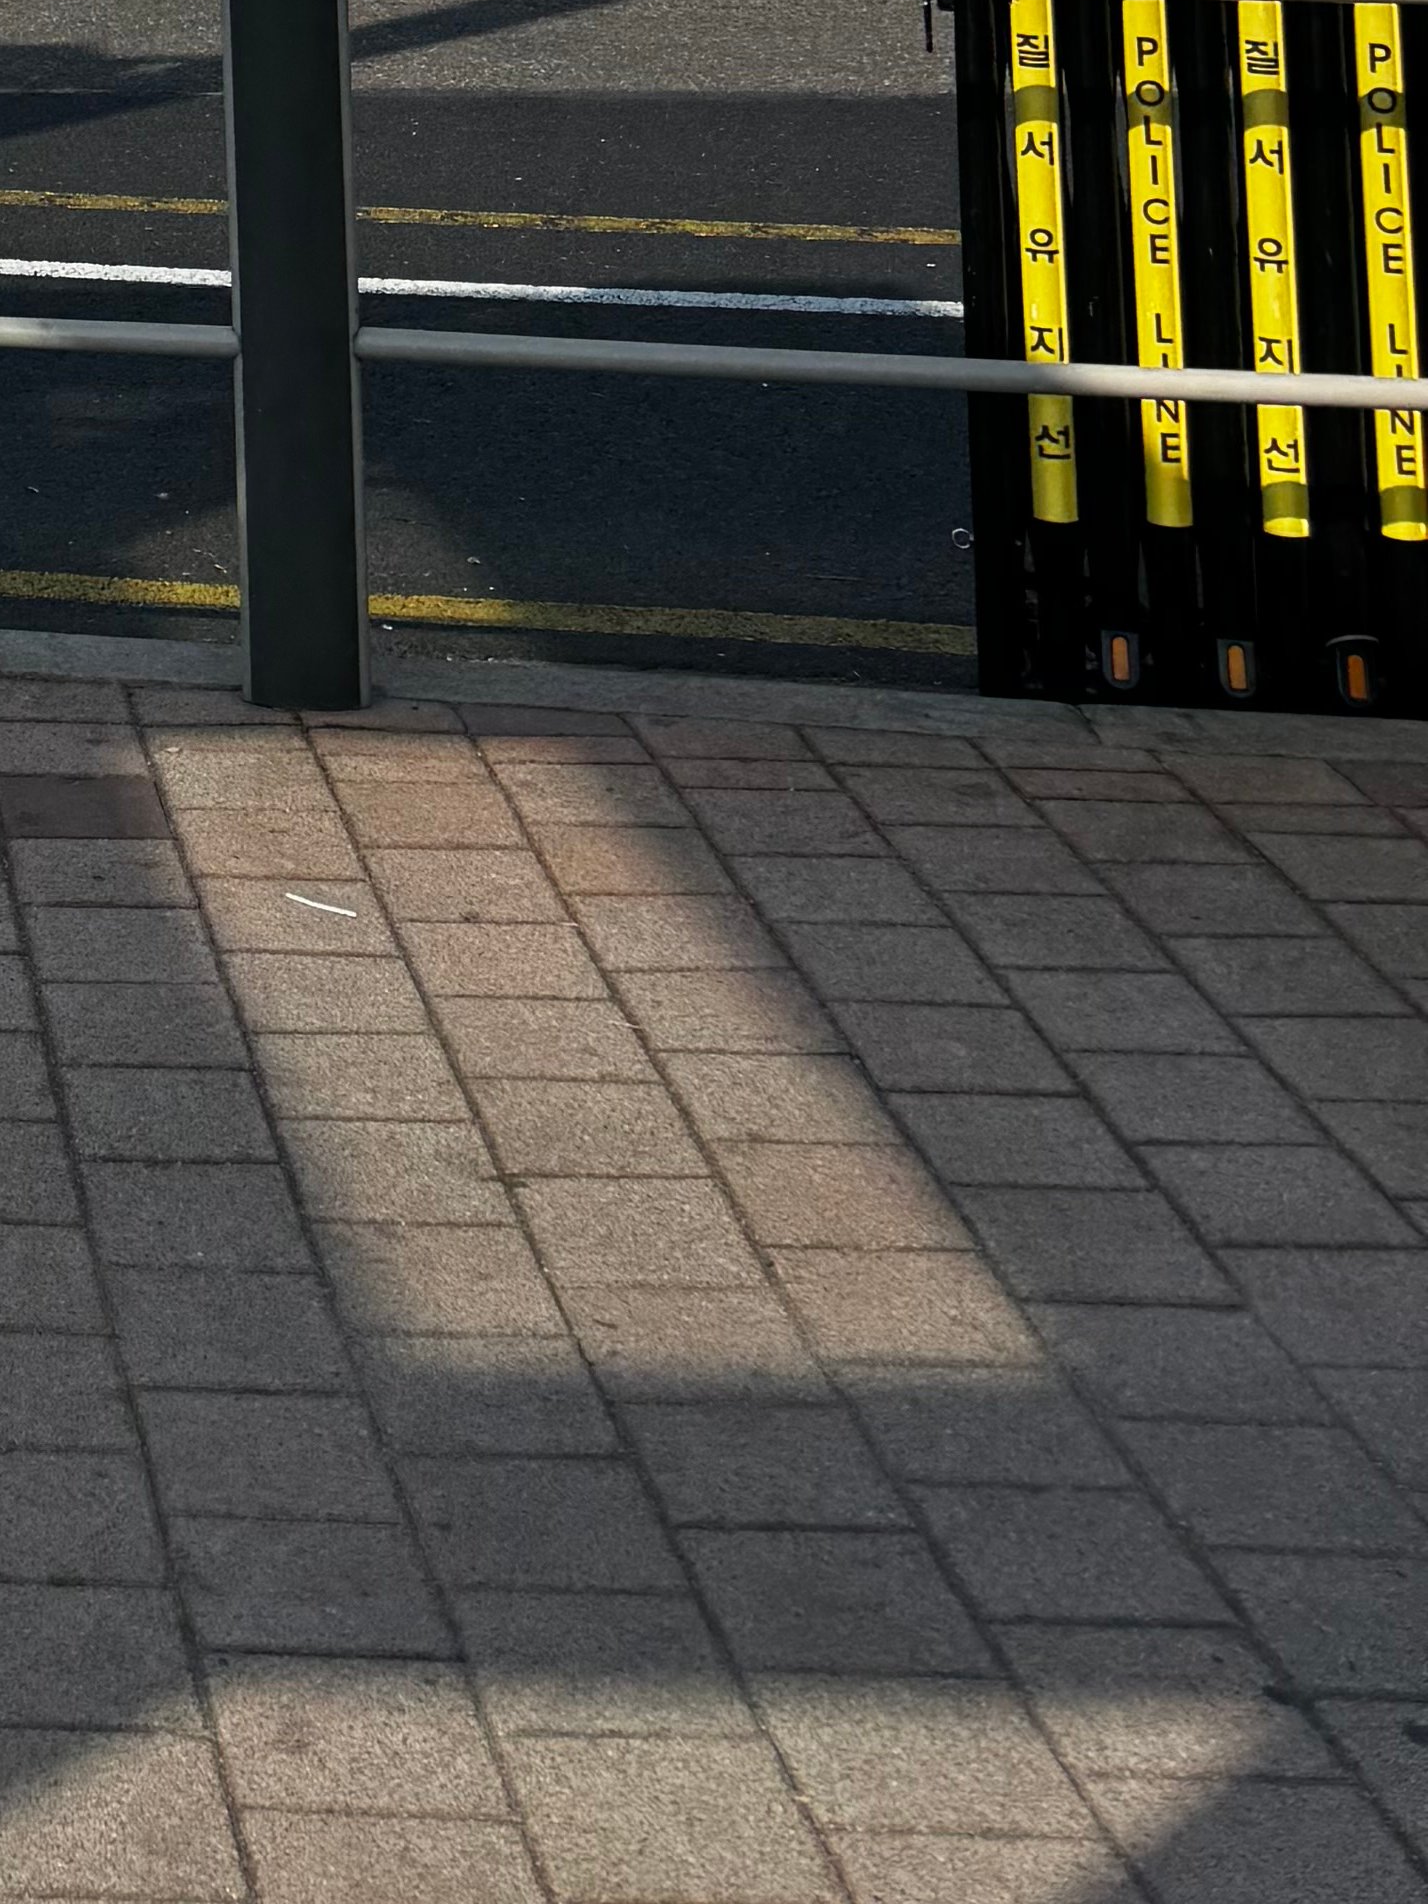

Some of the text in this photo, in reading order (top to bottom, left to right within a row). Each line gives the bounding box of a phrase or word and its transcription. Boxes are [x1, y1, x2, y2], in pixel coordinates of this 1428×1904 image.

[1016, 33, 1072, 461] 질서유지선
[1135, 36, 1170, 265] POLICE
[1245, 40, 1302, 474] 질서유지선
[1367, 42, 1404, 275] POLICE
